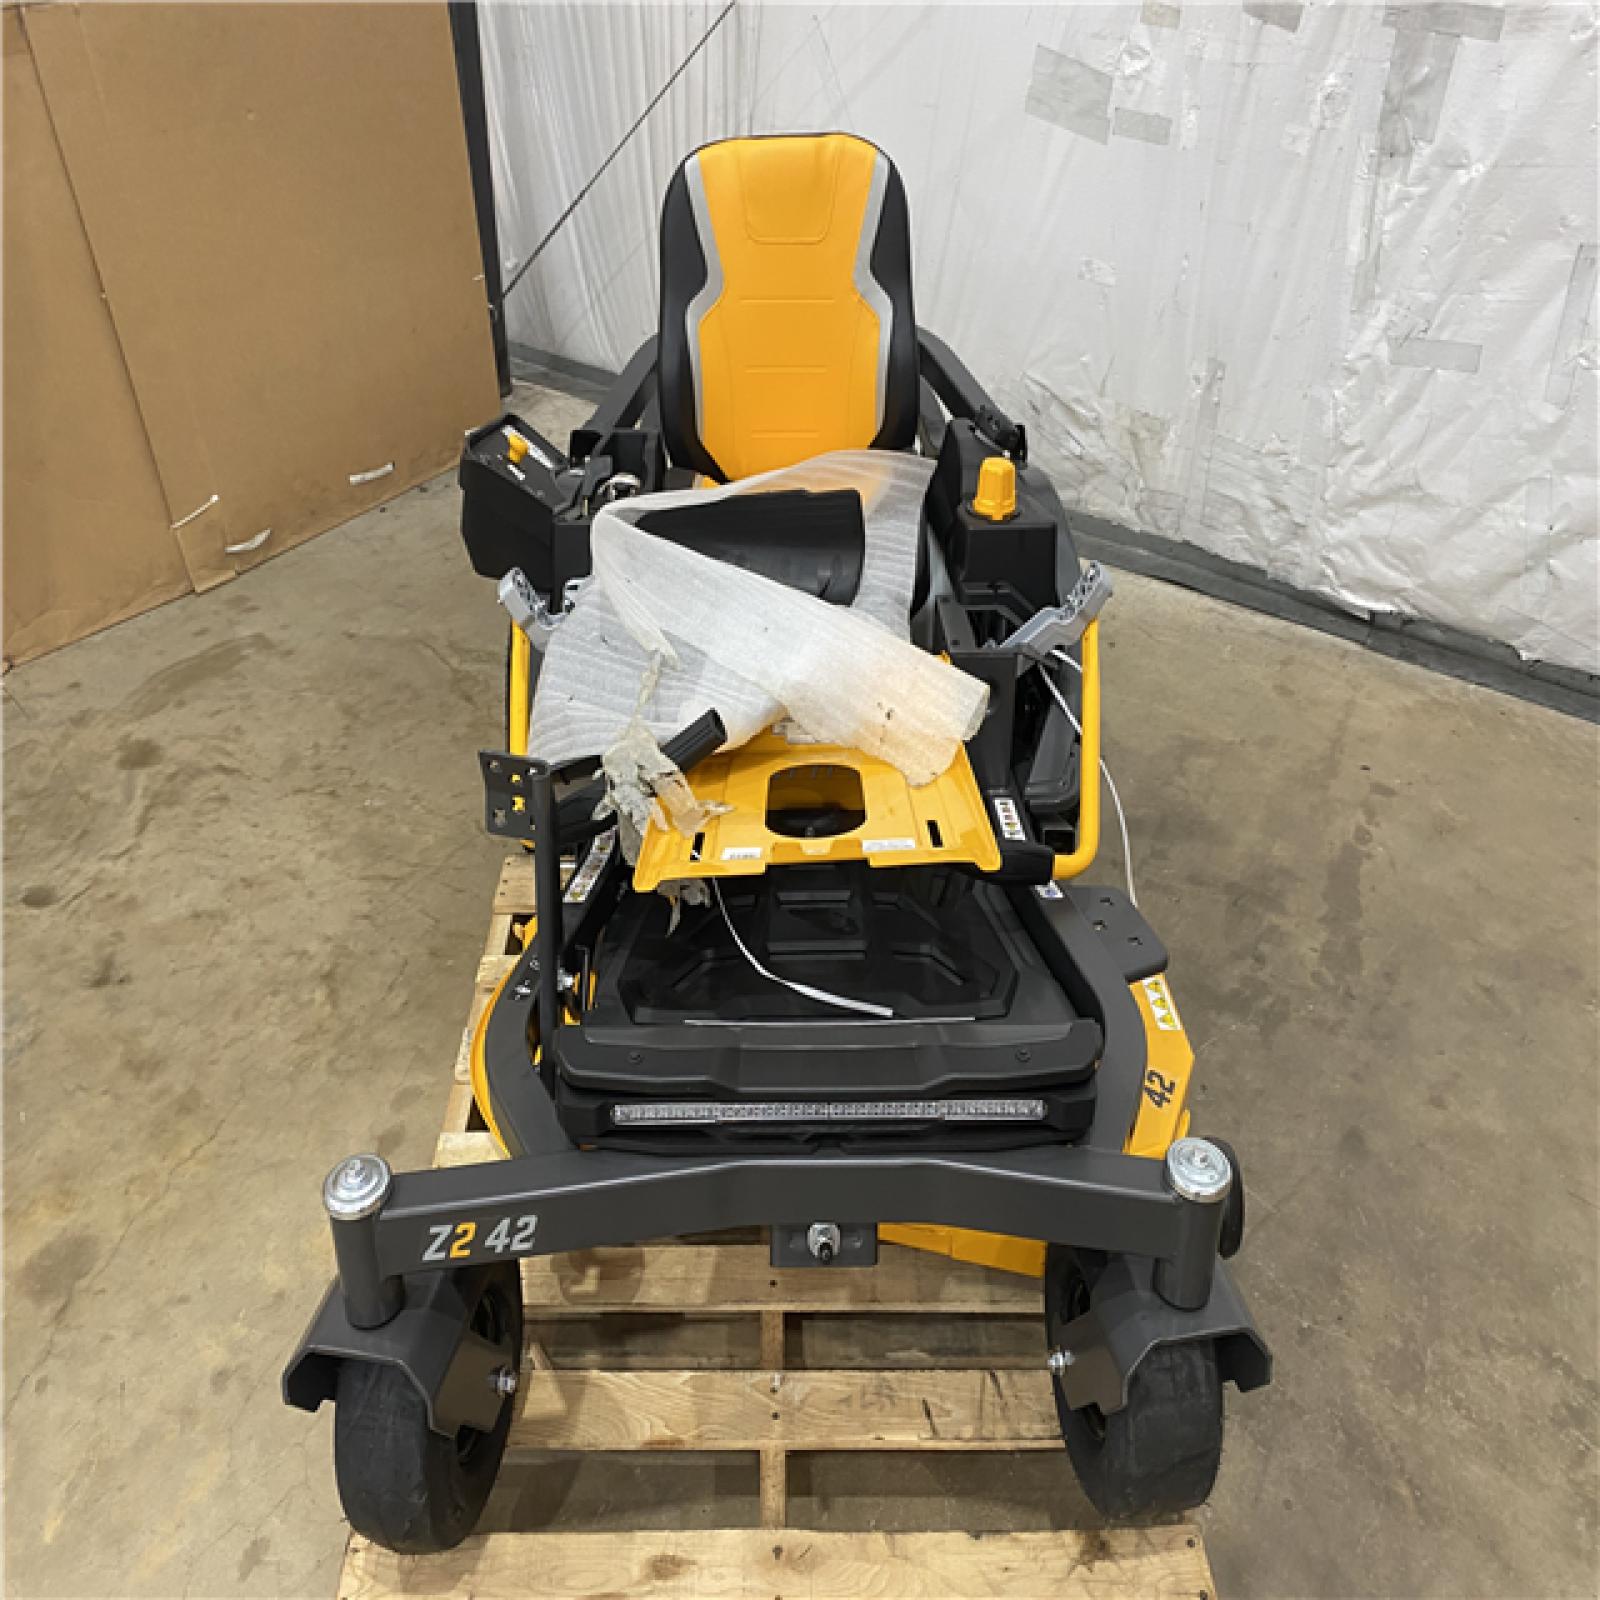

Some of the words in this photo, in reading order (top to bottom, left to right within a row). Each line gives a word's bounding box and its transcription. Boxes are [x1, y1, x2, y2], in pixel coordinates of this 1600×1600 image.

[1144, 1069, 1176, 1108] 42
[422, 1221, 477, 1261] Z2
[484, 1214, 538, 1253] 42
